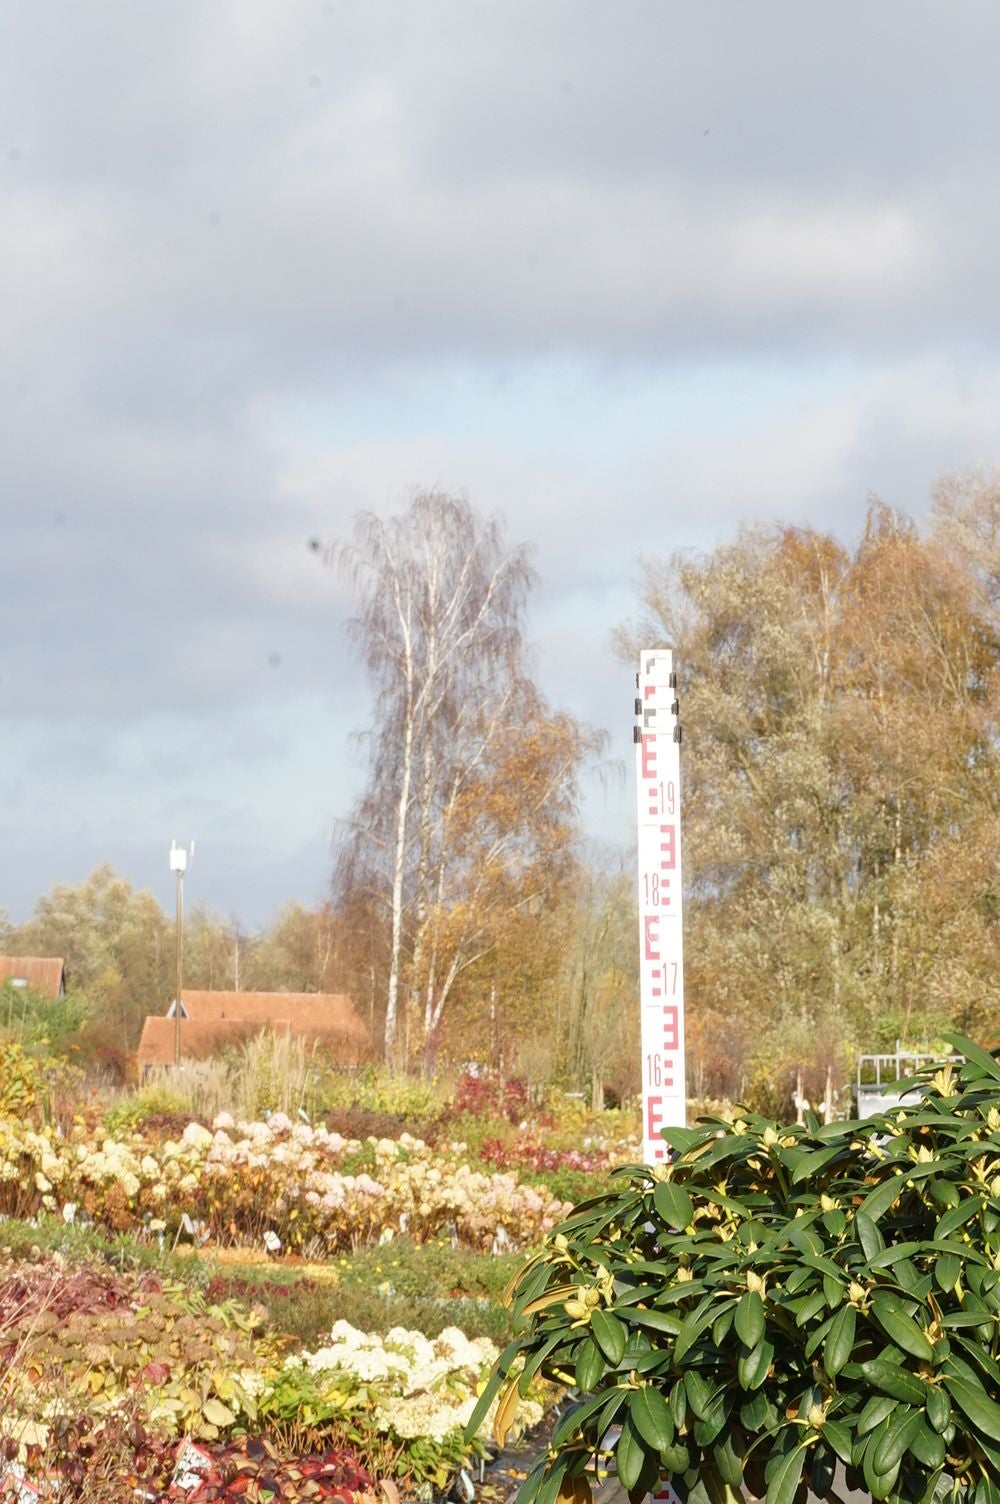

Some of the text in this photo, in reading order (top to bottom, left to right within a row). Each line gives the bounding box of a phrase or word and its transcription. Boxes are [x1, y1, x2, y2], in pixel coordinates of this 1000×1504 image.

[660, 781, 675, 815] 19
[644, 873, 659, 906] 18
[663, 962, 678, 995] 17
[647, 1053, 661, 1087] 16
